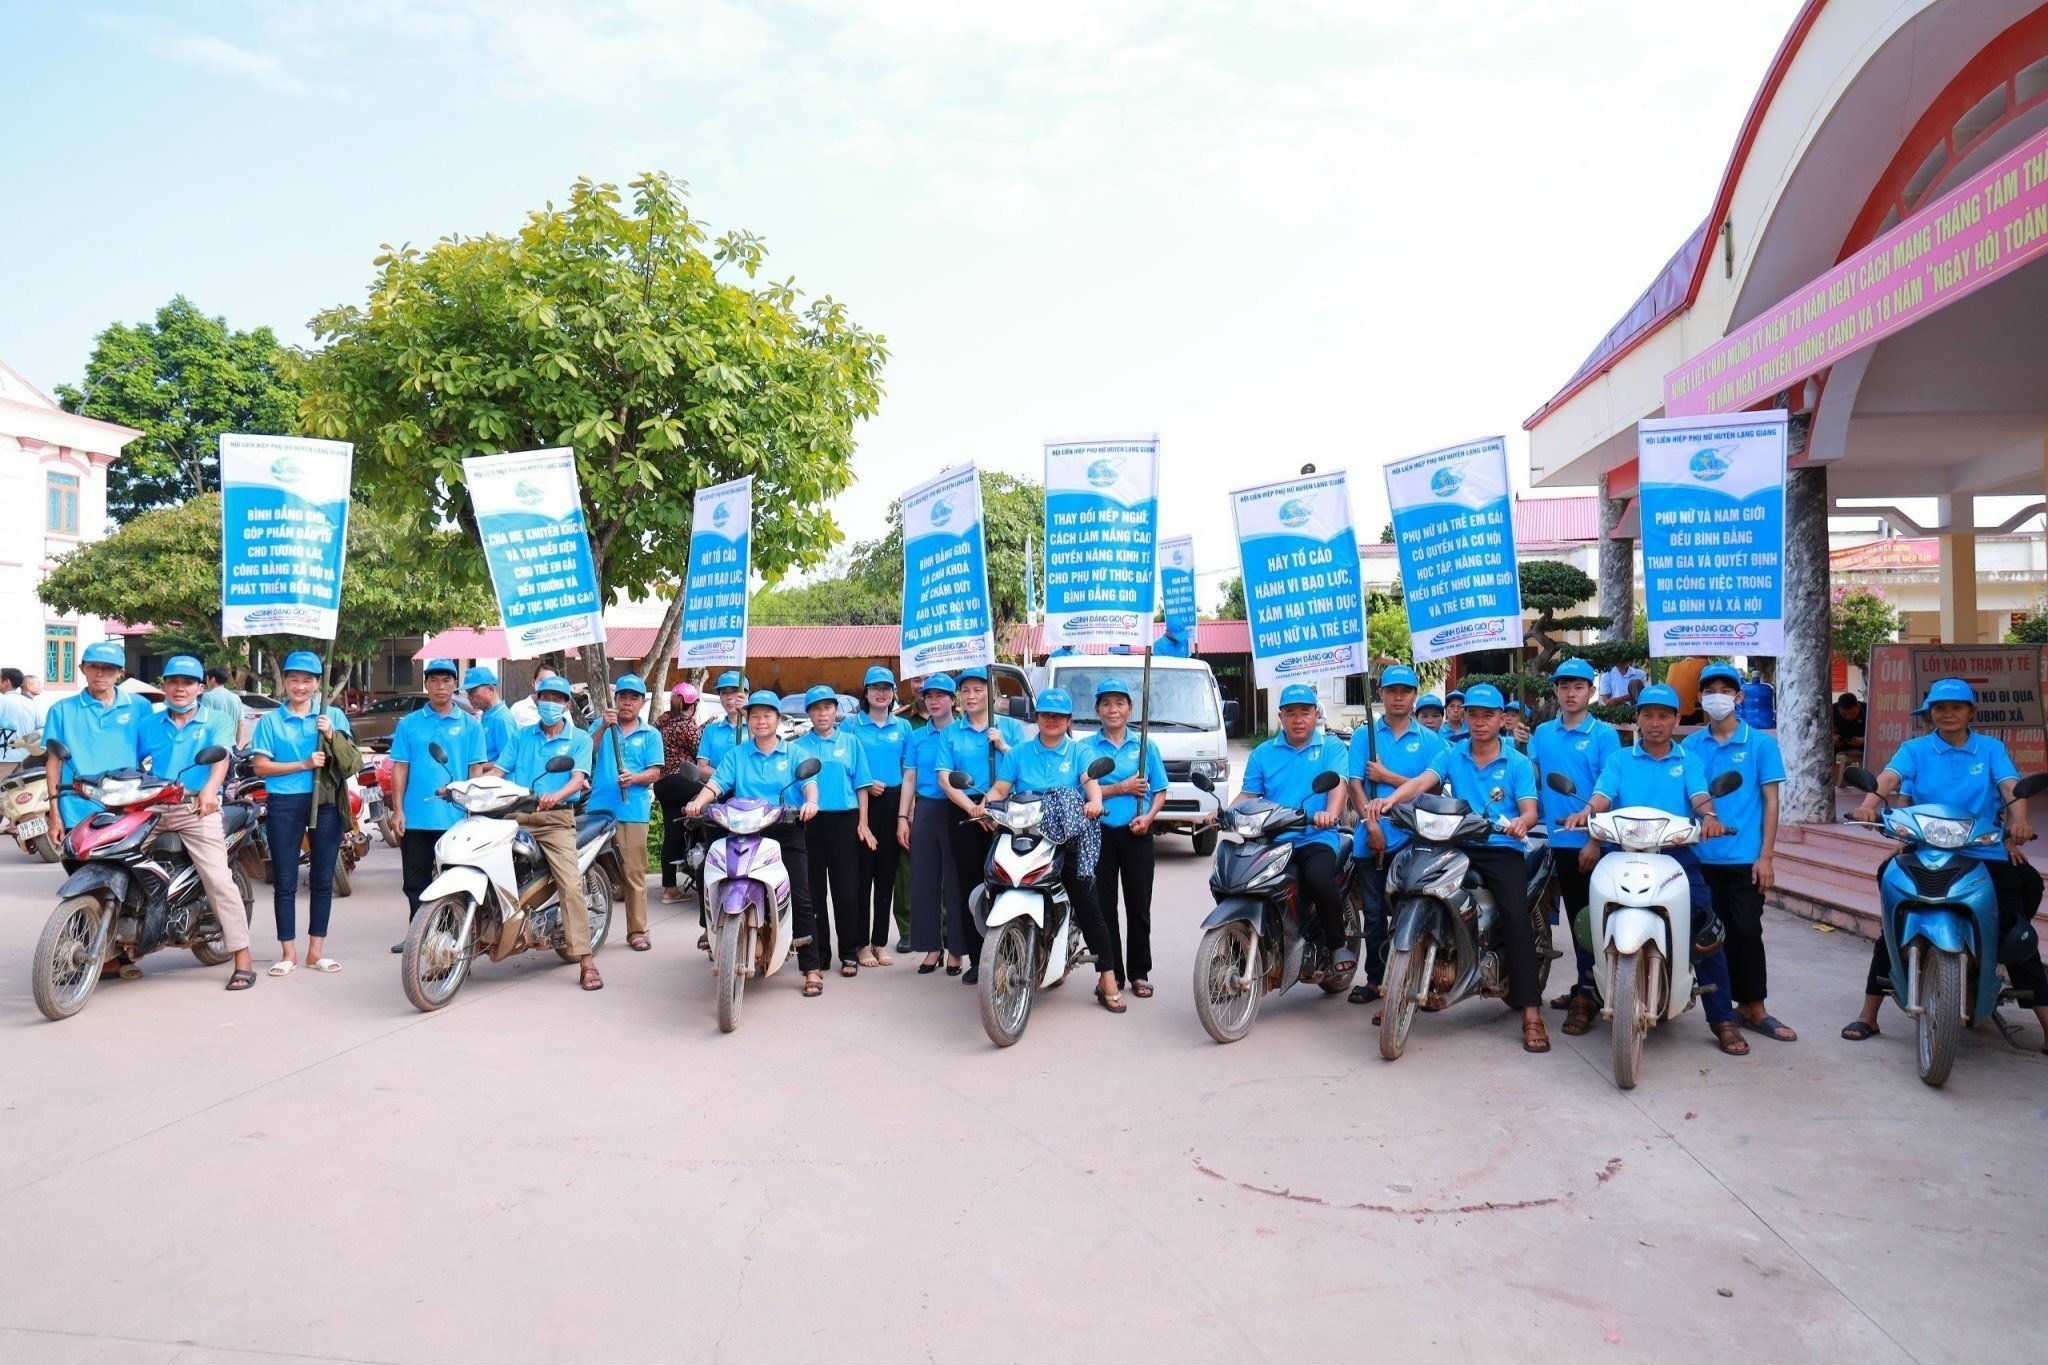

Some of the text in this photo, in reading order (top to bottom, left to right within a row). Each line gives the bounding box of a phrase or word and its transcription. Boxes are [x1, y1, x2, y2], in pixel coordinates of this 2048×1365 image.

[1707, 352, 1726, 380] CHÀO
[1766, 316, 1787, 347] NIỆM
[1790, 307, 1801, 332] 78
[1804, 290, 1826, 324] NĂM
[1829, 270, 1856, 309] NGÀY
[1860, 250, 1890, 290] CÁCH
[1894, 225, 1931, 271] MẠNG
[1935, 194, 1980, 245] THÁNG
[1985, 168, 2018, 215] TÁM
[1707, 394, 1715, 413] 78
[1737, 368, 1757, 398] NGÀY
[1794, 331, 1824, 368] THỐNG
[1828, 314, 1855, 349] CAND
[1859, 301, 1873, 332] VÀ
[1877, 294, 1890, 323] 18
[1893, 276, 1923, 316] NĂM
[1975, 230, 2000, 271] HỘI
[2004, 202, 2048, 253] TOÀN
[1756, 428, 1776, 437] GIANG
[1054, 513, 1077, 525] THAY
[1655, 505, 1765, 525] PHỤ NỮ VÀ NAM GIỚI
[244, 526, 263, 539] GÓP
[1050, 531, 1076, 546] CÁCH
[1079, 530, 1099, 544] LÀM
[1102, 527, 1131, 543] NÂNG
[1403, 511, 1503, 544] PHỤ NỮ VÀ TRẺ EM GÁI
[1694, 528, 1720, 545] BÌNH
[1723, 524, 1752, 543] ĐẲNG
[248, 546, 267, 557] CHO
[1116, 549, 1139, 563] KINH
[1412, 546, 1424, 562] CÓ
[1456, 534, 1469, 550] VÀ
[1471, 532, 1485, 547] CƠ
[1487, 531, 1501, 547] HỘI
[1292, 545, 1306, 568] TỐ
[1309, 546, 1332, 565] CÁO
[1648, 550, 1777, 569] THAM GIA VÀ QUYẾT ĐỊNH
[233, 563, 259, 576] CÔNG
[1049, 571, 1068, 584] CHO
[1071, 570, 1089, 586] PHỤ
[1109, 566, 1133, 583] THÚC
[1417, 565, 1434, 581] HỌC
[1455, 552, 1482, 571] NÂNG
[1485, 553, 1501, 567] CAO
[231, 581, 256, 595] PHÁT
[1255, 569, 1352, 599] HÀNH VI BẠO LỰC,
[1431, 578, 1449, 597] BIẾT
[1452, 575, 1471, 592] NHƯ
[1473, 573, 1494, 589] NAM
[1496, 570, 1513, 586] GIỚI
[1657, 574, 1772, 592] MỌI CÔNG VIỆC TRONG
[1063, 588, 1085, 604] BÌNH
[1119, 587, 1137, 602] GIỚI
[1662, 594, 1761, 613] GIA ĐÌNH VÀ XÃ HỘI
[1258, 593, 1357, 624] XÂM HẠI TÌNH DỤC
[1429, 594, 1496, 618] VÀ TRẺ EM TRAI
[964, 617, 978, 630] EM
[1259, 617, 1360, 649] PHỤ NỮ VÀ TRẺ EM.
[1944, 653, 1968, 671] VÀO
[1970, 657, 2003, 674] TRẠM
[2007, 657, 2014, 670] Y
[1983, 691, 1995, 701] KO
[2013, 691, 2033, 702] QUA
[1977, 710, 2006, 722] UBND
